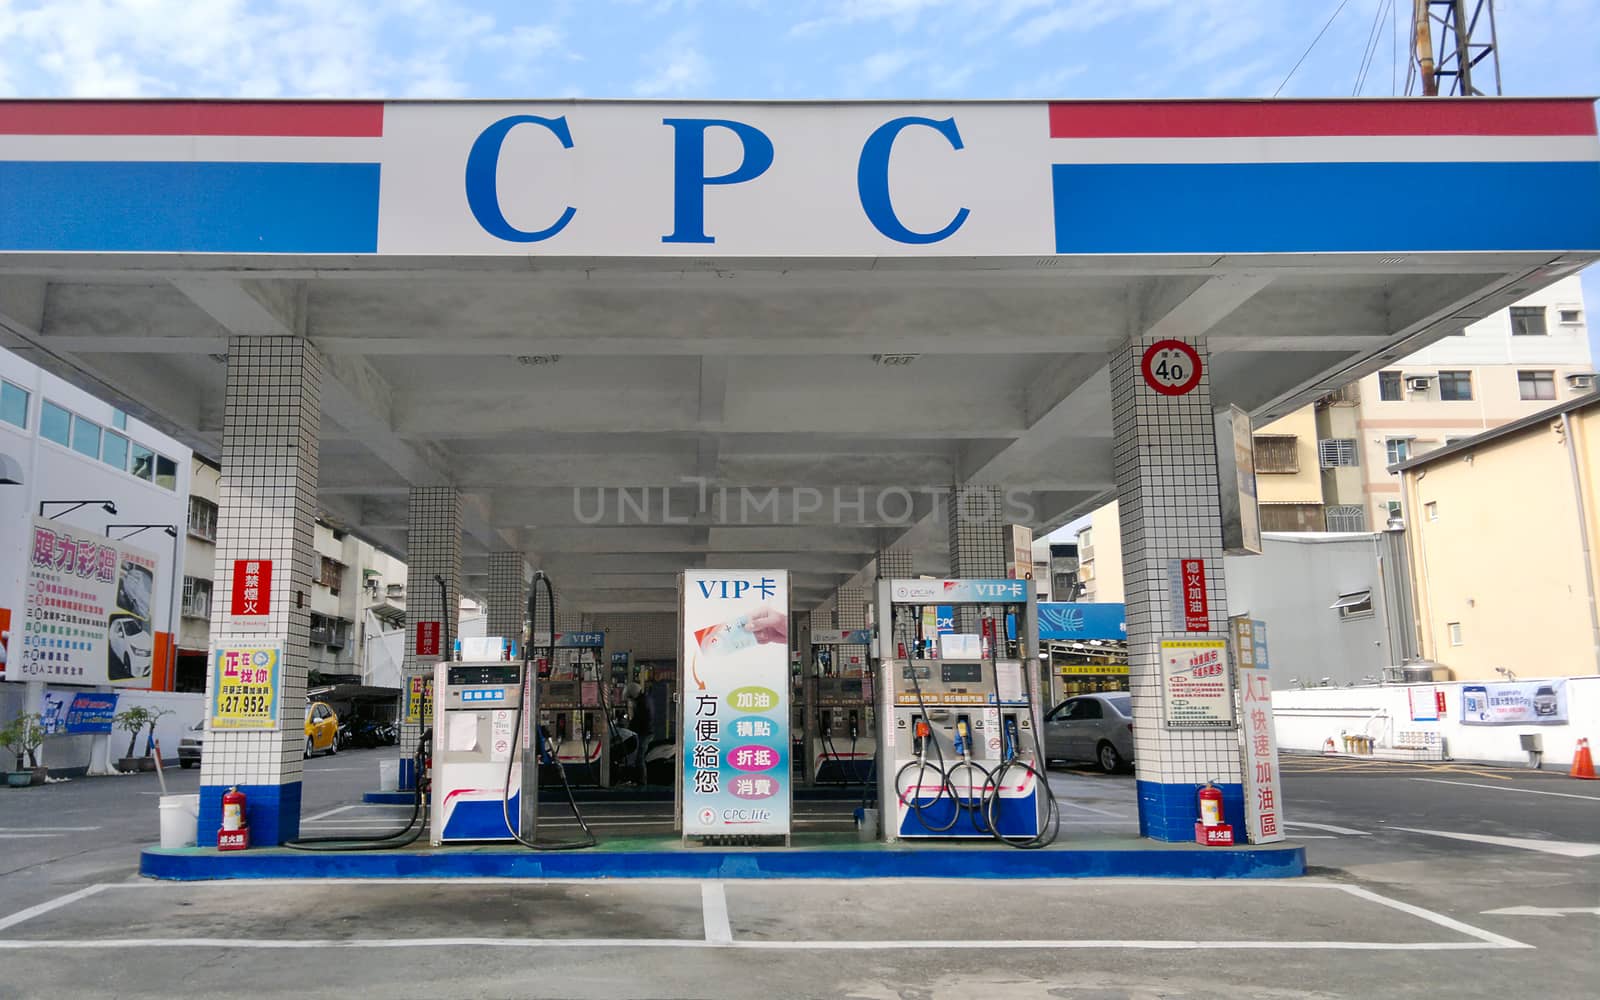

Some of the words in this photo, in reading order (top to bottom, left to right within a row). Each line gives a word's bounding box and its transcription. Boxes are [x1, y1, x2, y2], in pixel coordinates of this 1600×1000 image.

[465, 114, 971, 244] CPC
[243, 562, 260, 614] 嚴禁煙火
[697, 577, 776, 600] VIP卡
[975, 583, 1023, 597] VIP卡
[1187, 562, 1202, 613] 熄火加油
[736, 693, 770, 707] 加油
[694, 695, 719, 793] 方便給您
[736, 750, 771, 766] 折抵
[736, 779, 770, 795] 消費
